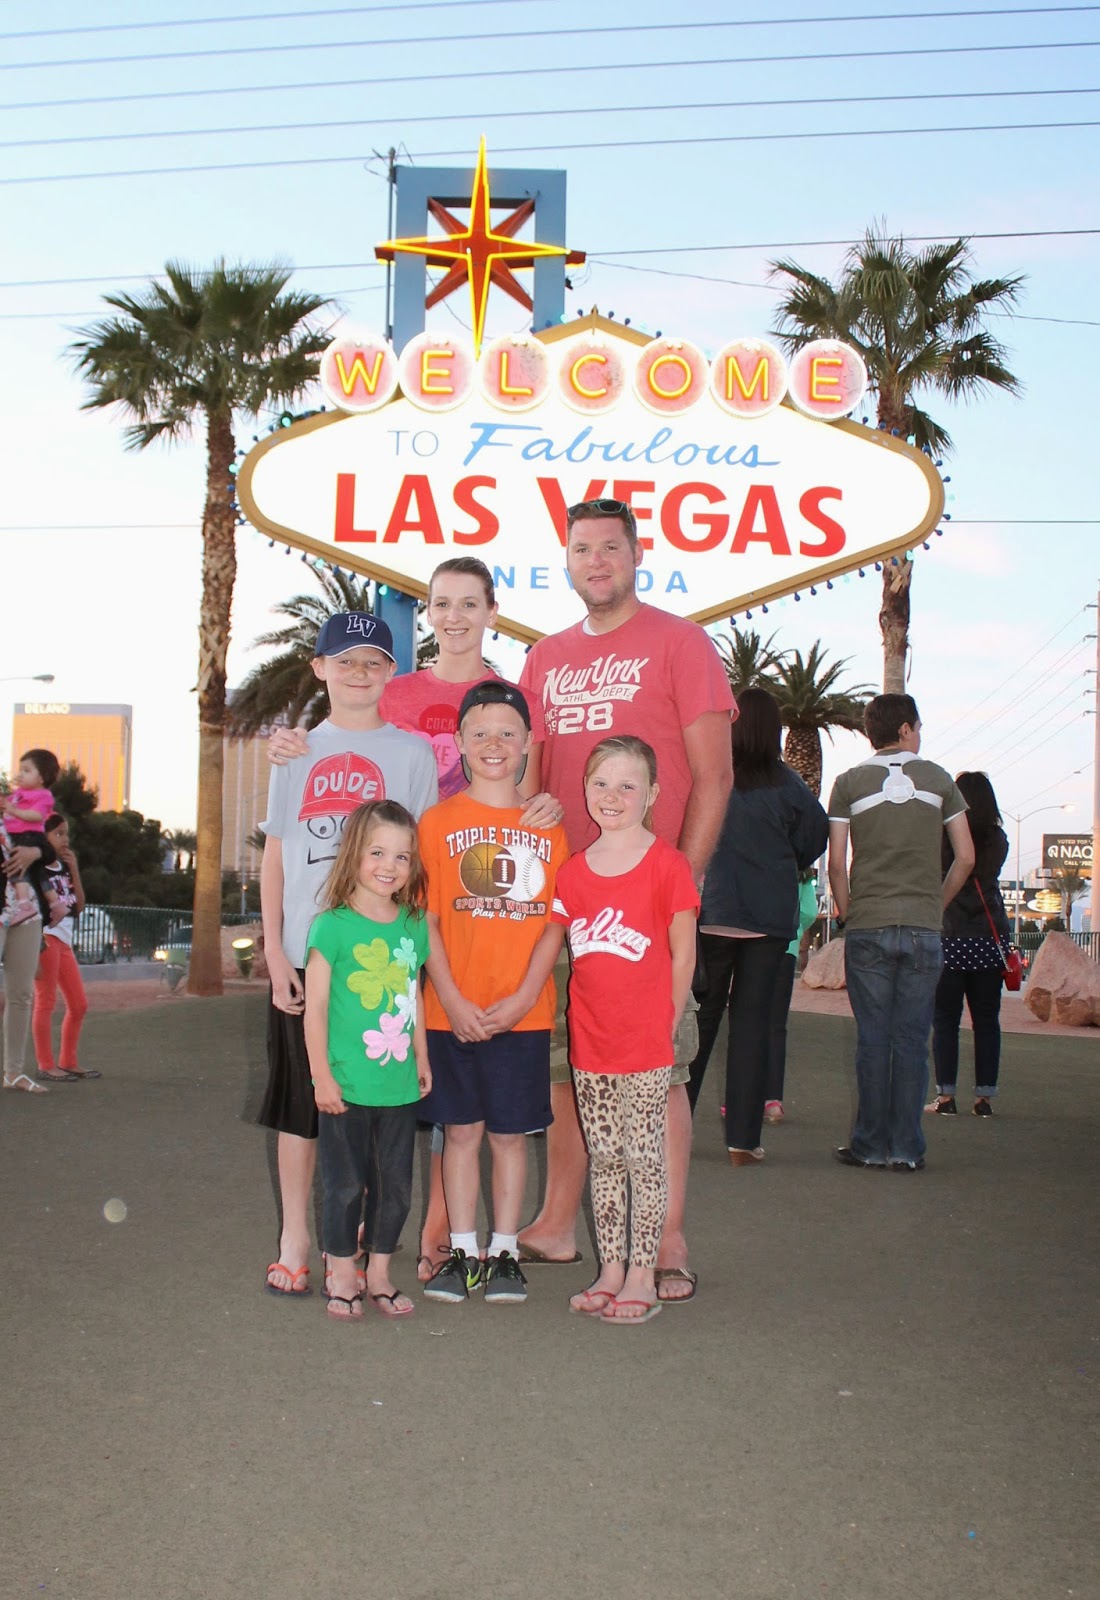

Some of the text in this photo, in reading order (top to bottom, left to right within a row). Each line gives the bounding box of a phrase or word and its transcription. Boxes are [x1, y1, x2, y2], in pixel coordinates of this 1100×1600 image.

[333, 349, 843, 402] WELCOME
[386, 421, 781, 468] TO Fabulous
[333, 472, 848, 558] LAS VEGAS
[493, 565, 689, 594] NEDA
[346, 614, 377, 639] LV
[542, 653, 651, 711] New York
[557, 701, 614, 735] 28
[313, 772, 378, 800] DUDE
[445, 826, 552, 864] TRIPLE THREAT
[455, 897, 546, 915] SPORTS WORLD
[471, 908, 495, 919] Play
[499, 909, 507, 919] it
